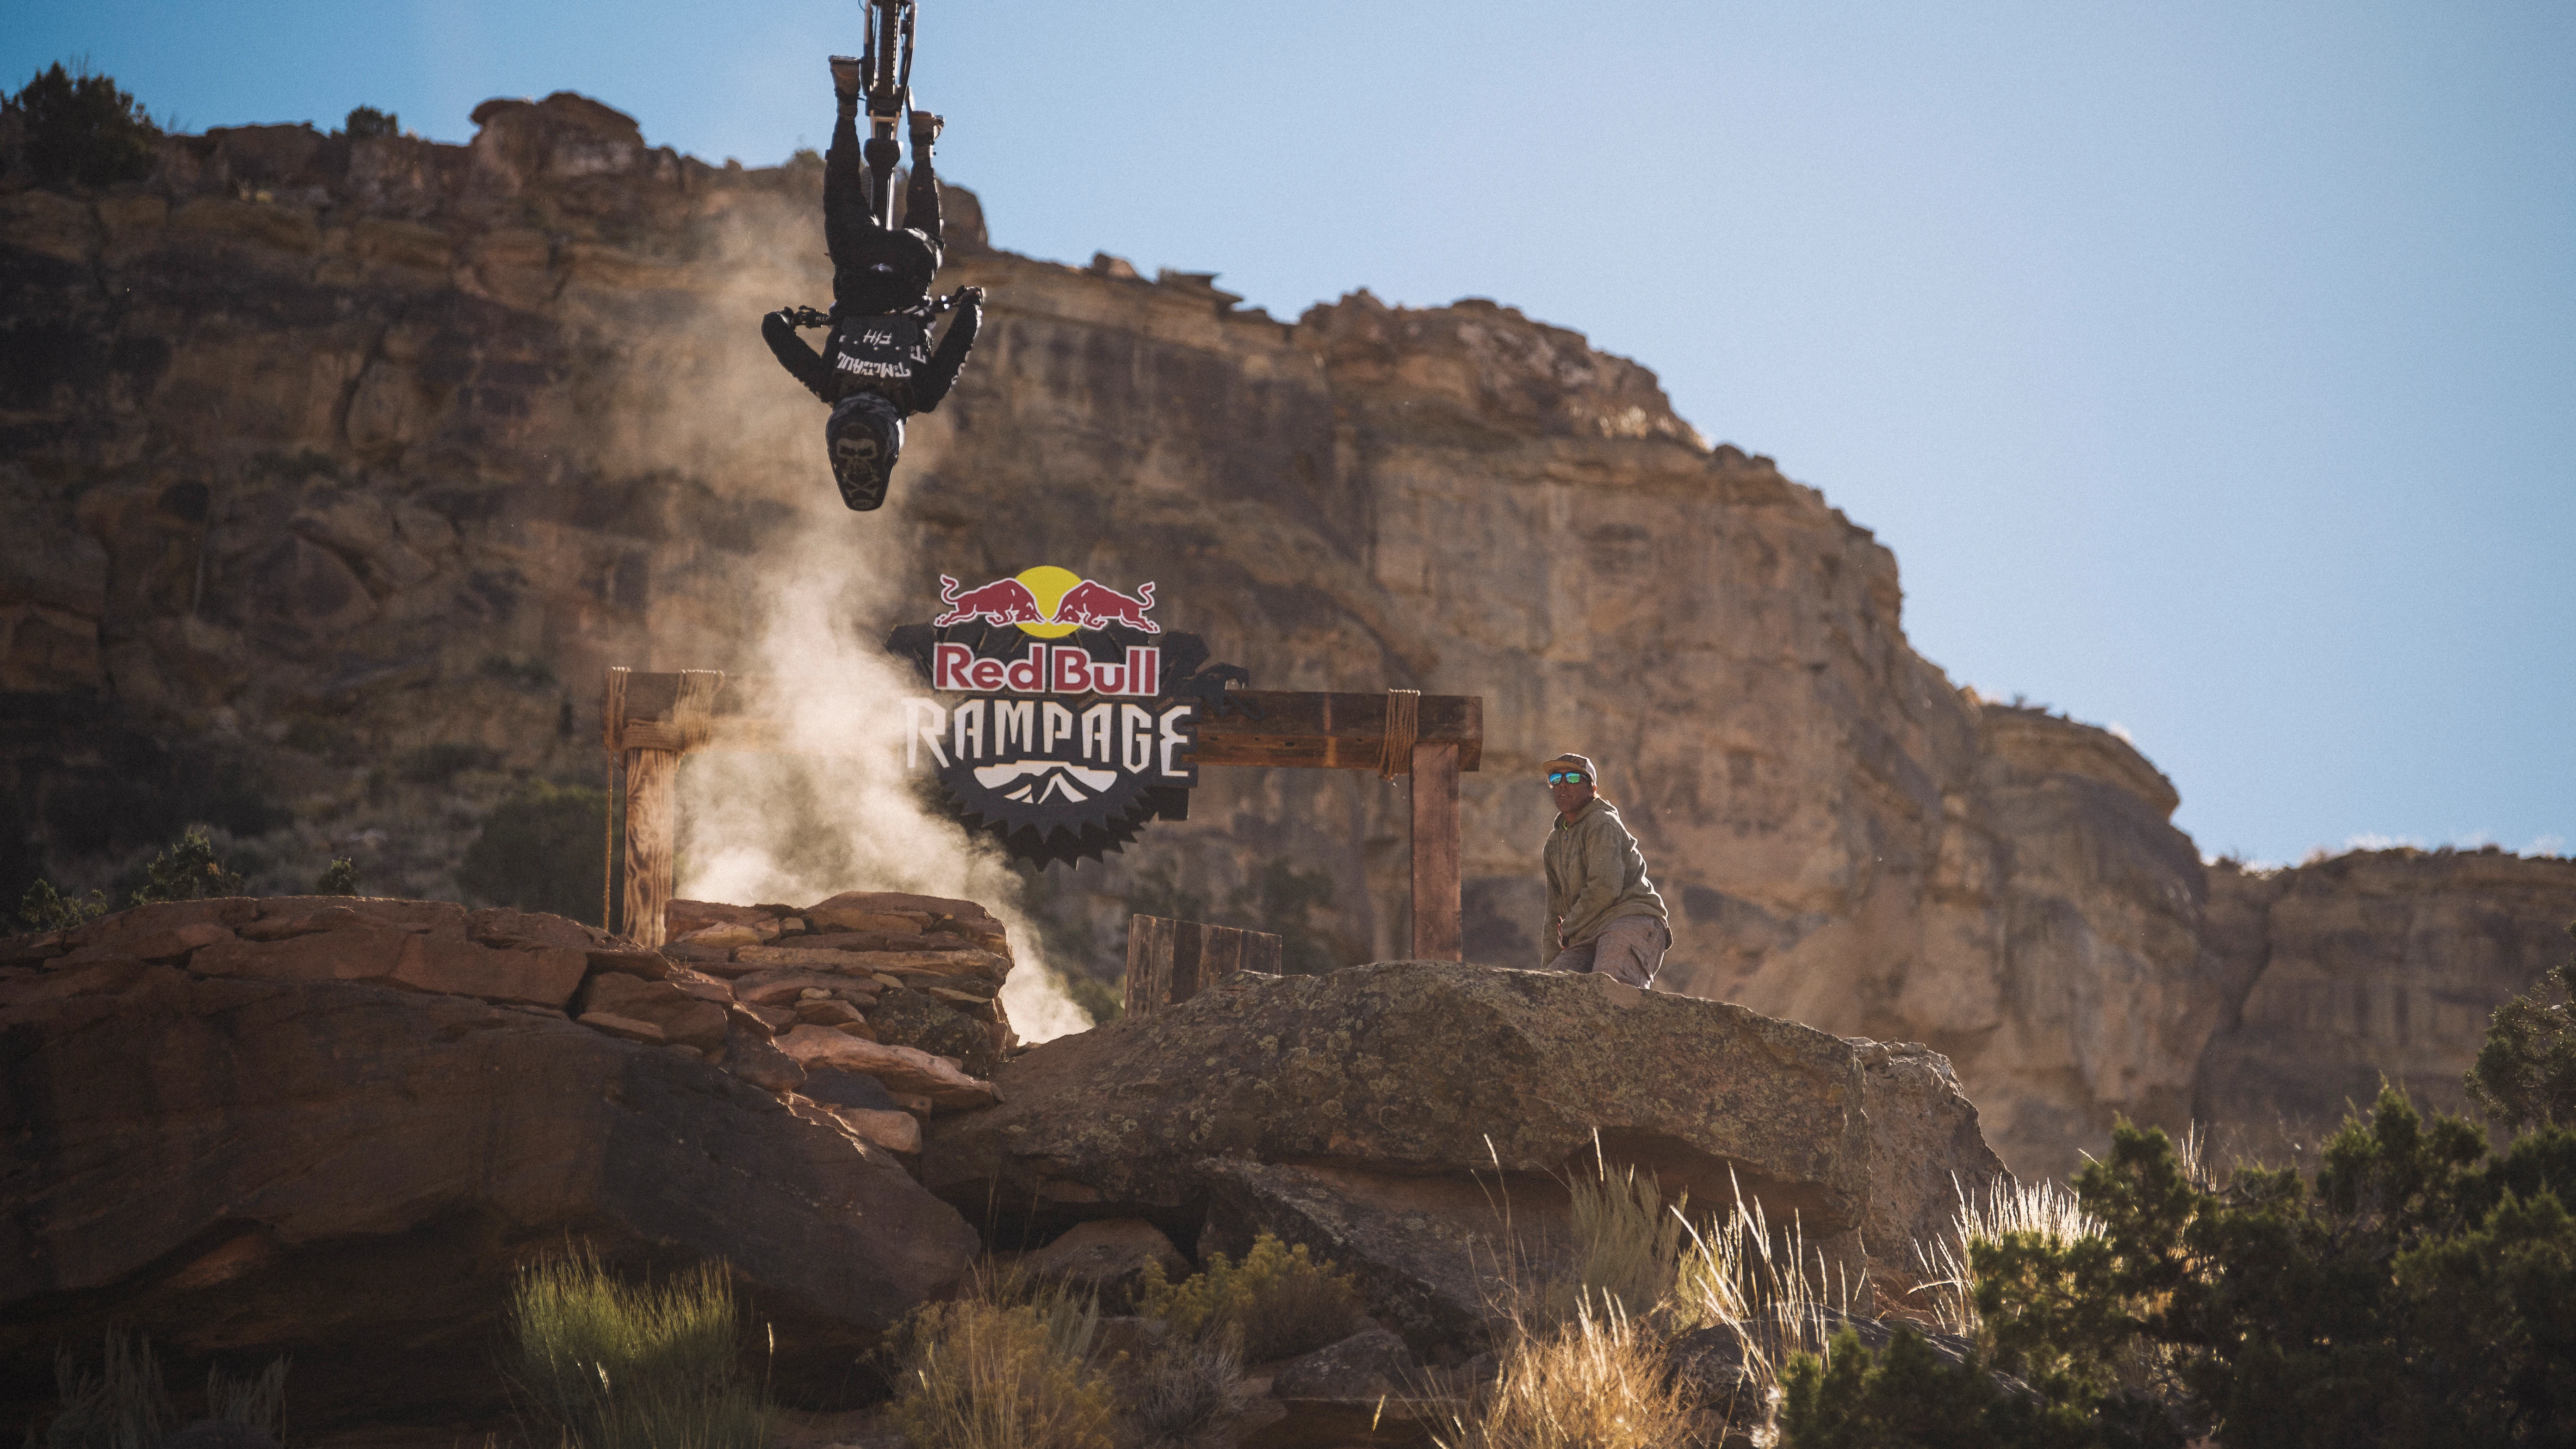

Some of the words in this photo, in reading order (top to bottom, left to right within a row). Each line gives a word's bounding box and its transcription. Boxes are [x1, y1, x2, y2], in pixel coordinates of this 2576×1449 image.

[935, 644, 1044, 690] Red
[1053, 648, 1158, 695] Bull
[900, 697, 1191, 777] RAMPAGE
